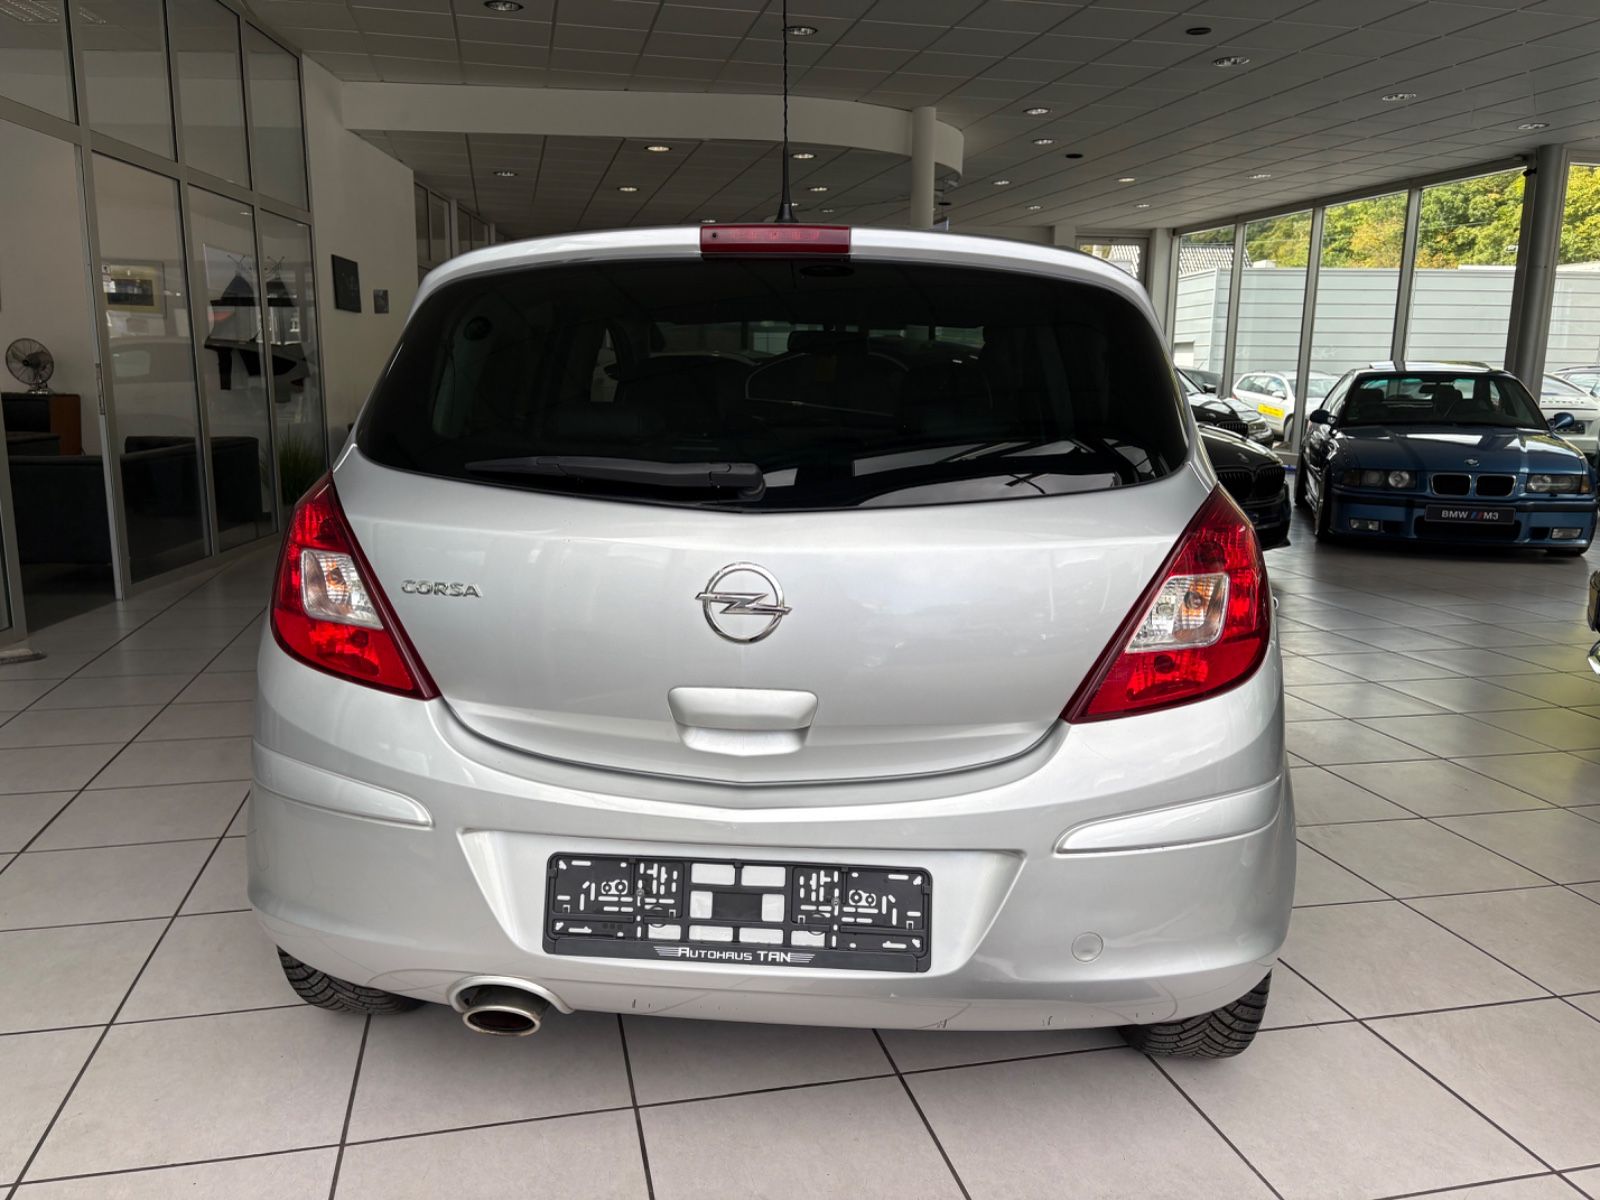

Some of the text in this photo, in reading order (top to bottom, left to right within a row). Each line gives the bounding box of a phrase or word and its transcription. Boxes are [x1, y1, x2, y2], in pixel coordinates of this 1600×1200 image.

[1442, 510, 1499, 520] BMW M3
[401, 579, 482, 598] CORSA
[677, 946, 790, 964] AUTOHAUS TAN
